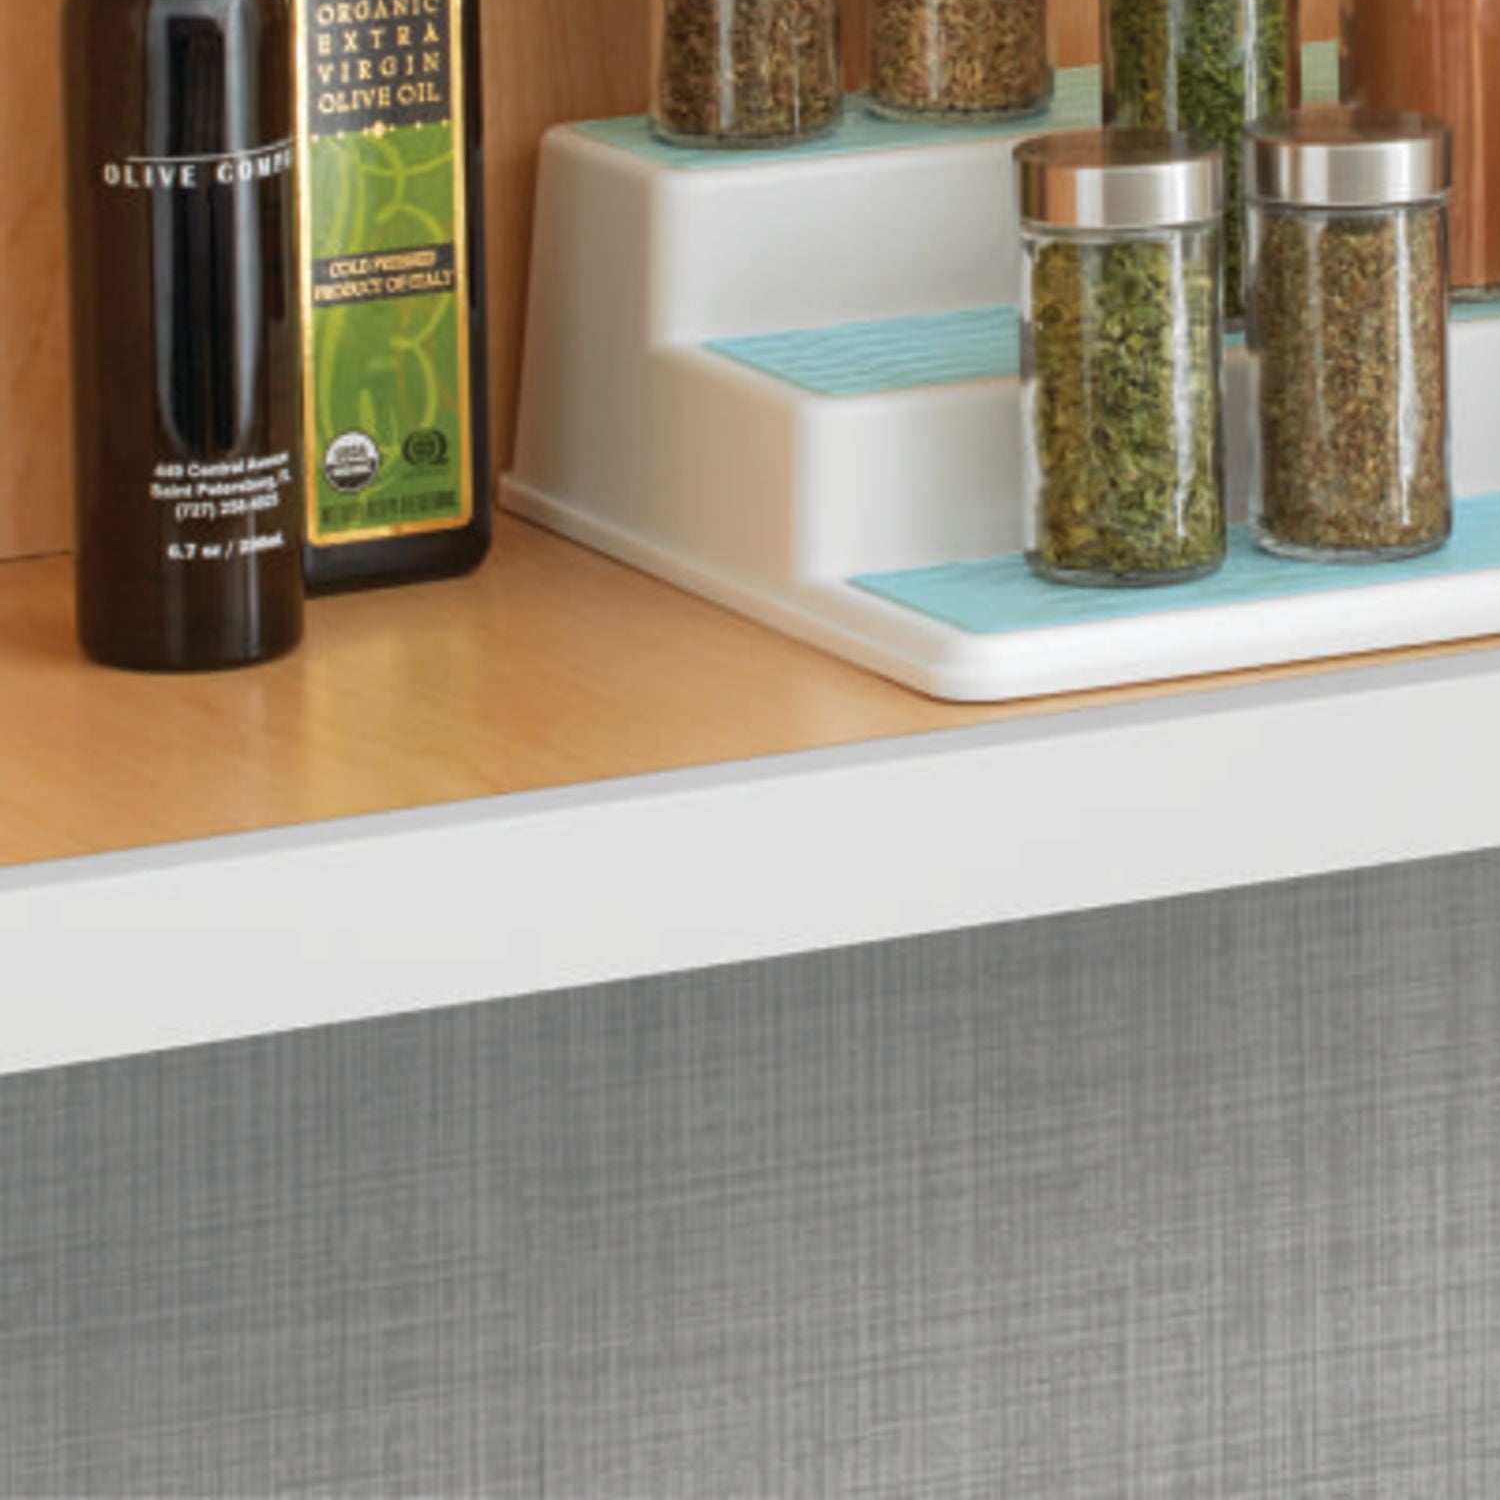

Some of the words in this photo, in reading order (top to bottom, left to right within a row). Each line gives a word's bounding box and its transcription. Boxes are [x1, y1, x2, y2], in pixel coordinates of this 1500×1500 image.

[317, 22, 440, 56] EXTRA
[317, 51, 440, 84] VIRGIN
[317, 86, 391, 114] OLIVE
[397, 82, 441, 105] OIL
[103, 163, 196, 188] OLIVE
